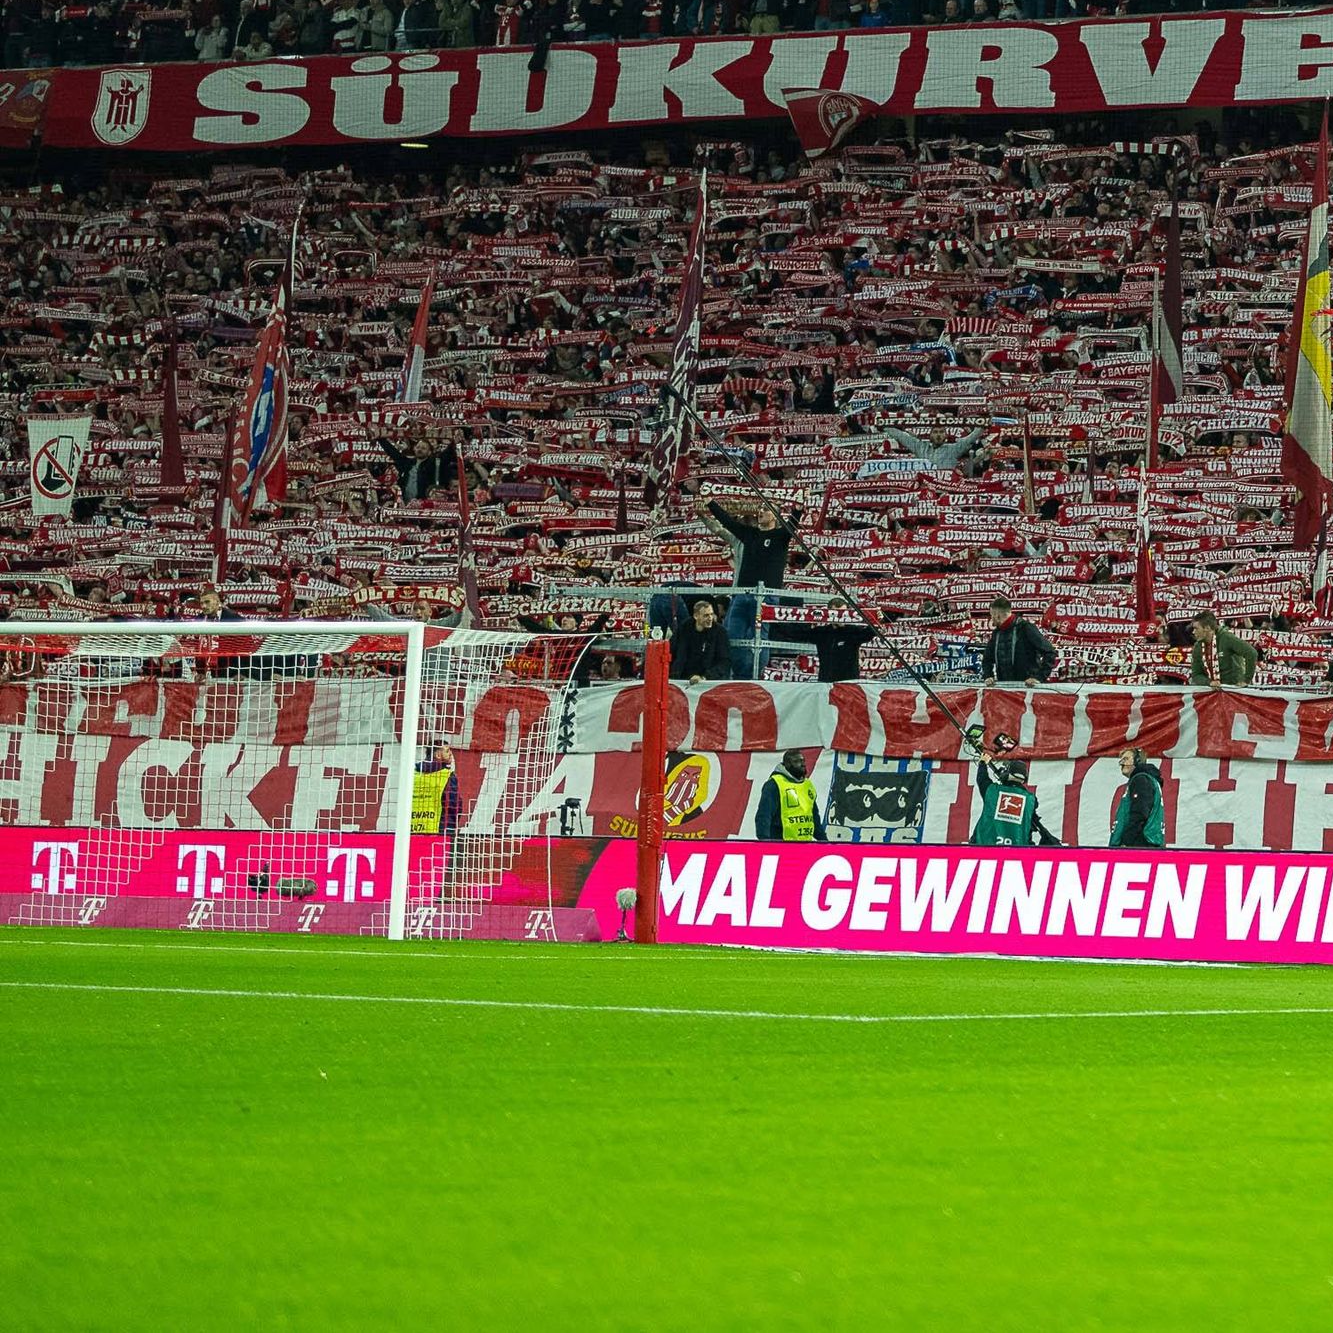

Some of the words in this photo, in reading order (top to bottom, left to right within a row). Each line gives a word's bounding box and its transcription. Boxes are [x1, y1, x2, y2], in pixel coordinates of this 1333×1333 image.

[701, 482, 804, 502] SCHICKERIA
[1056, 603, 1137, 620] SÜDKURVE
[660, 853, 786, 927] MAL
[801, 854, 1207, 940] GEWINNEN
